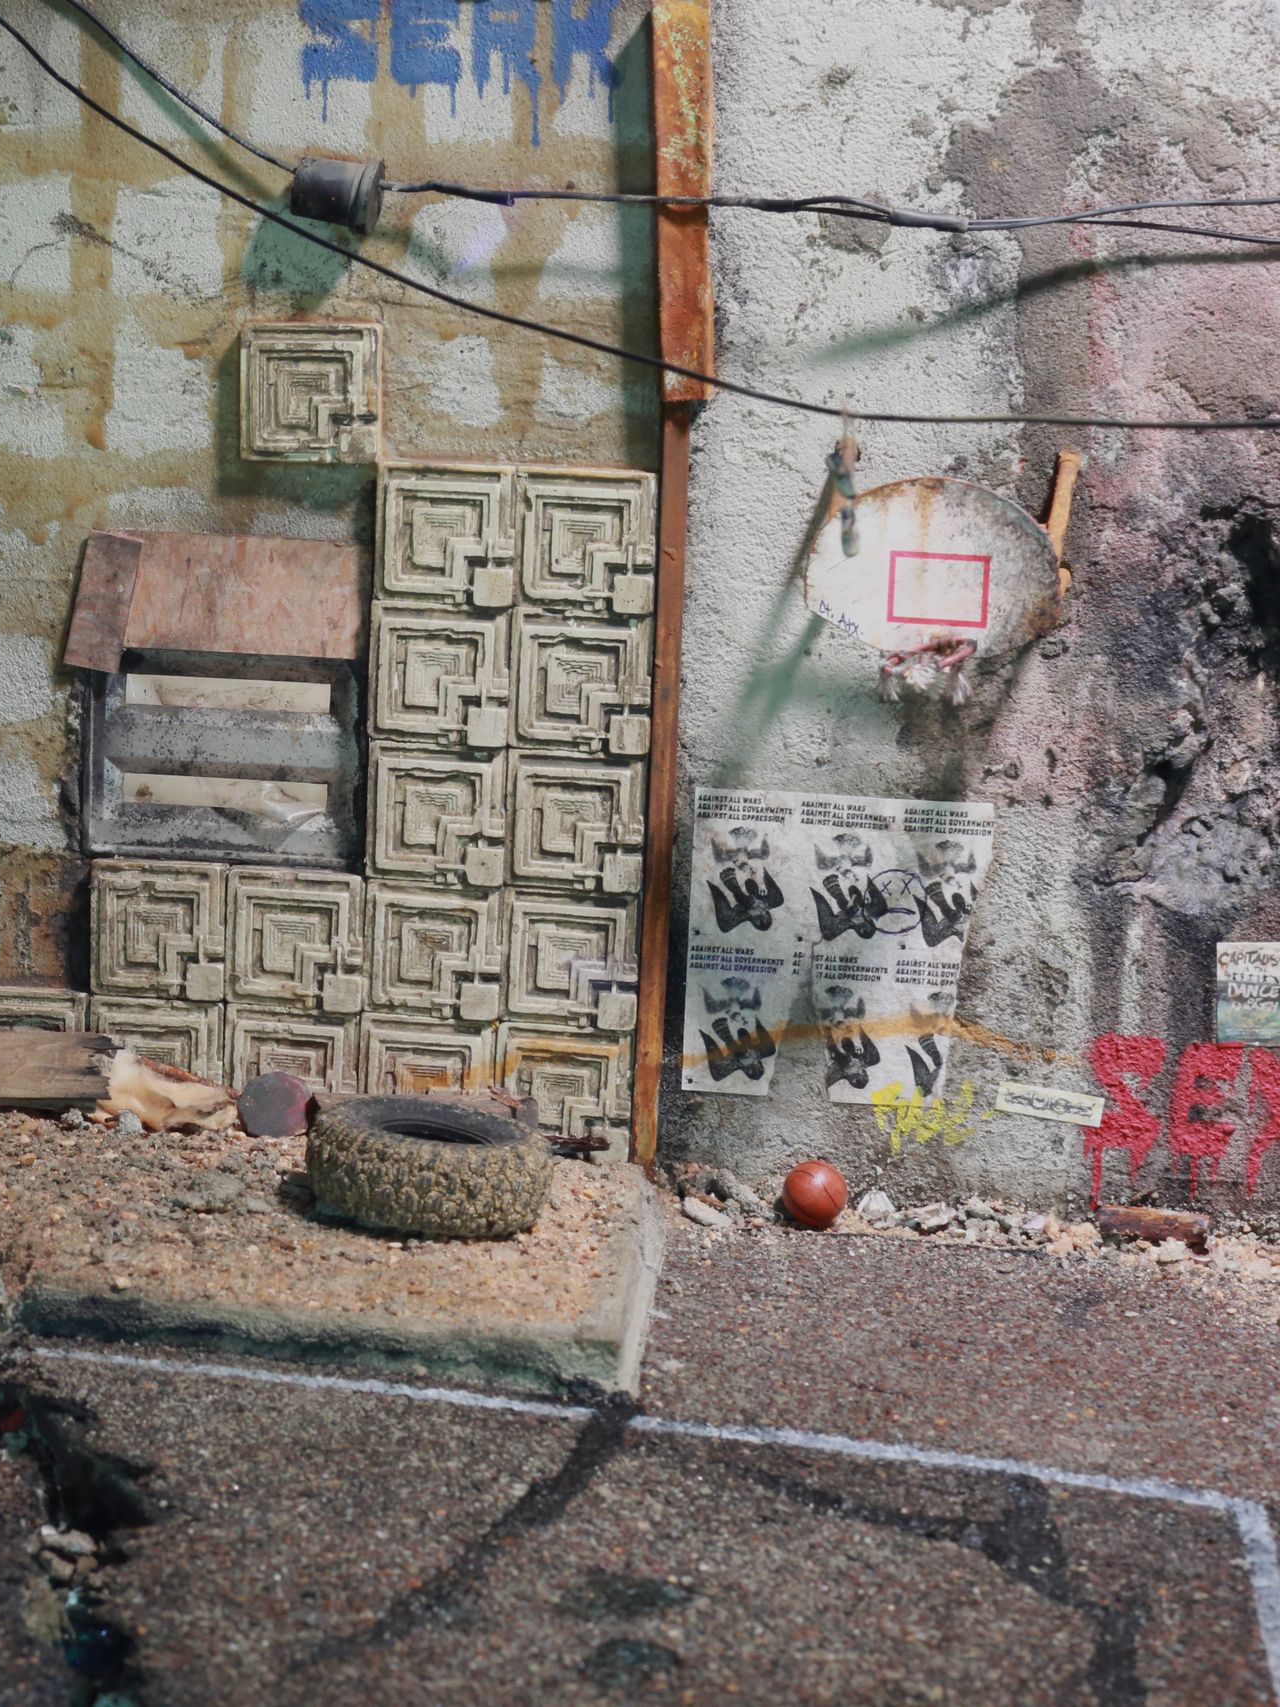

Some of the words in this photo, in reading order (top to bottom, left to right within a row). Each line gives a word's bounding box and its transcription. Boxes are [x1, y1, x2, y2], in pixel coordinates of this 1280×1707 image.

[698, 794, 728, 803] AGAINST
[697, 803, 727, 811] AGAINST
[742, 806, 793, 815] GOVERNMENTS
[801, 801, 832, 809] AGAINST
[801, 809, 831, 817] AGAINST
[846, 813, 896, 823] GOVERNMENTS
[904, 808, 934, 816] AGAINST
[697, 812, 727, 820] AGAINST
[742, 814, 785, 823] OPPRESSION
[904, 817, 934, 825] AGAINST
[800, 818, 831, 826] AGAINST
[846, 821, 889, 831] OPPRESSION
[948, 828, 992, 836] OPPRESSION
[690, 945, 720, 953] AGAINST
[721, 946, 733, 954] ALL
[721, 955, 733, 963] ALL
[734, 956, 785, 966] GOVERNMENTS
[720, 963, 733, 971] ALL
[734, 964, 777, 973] OPPRESSION
[838, 964, 888, 974] GOVERNMENTS
[896, 968, 926, 976] AGAINST
[837, 973, 881, 981] OPPRESSION
[895, 977, 925, 985] AGAINST
